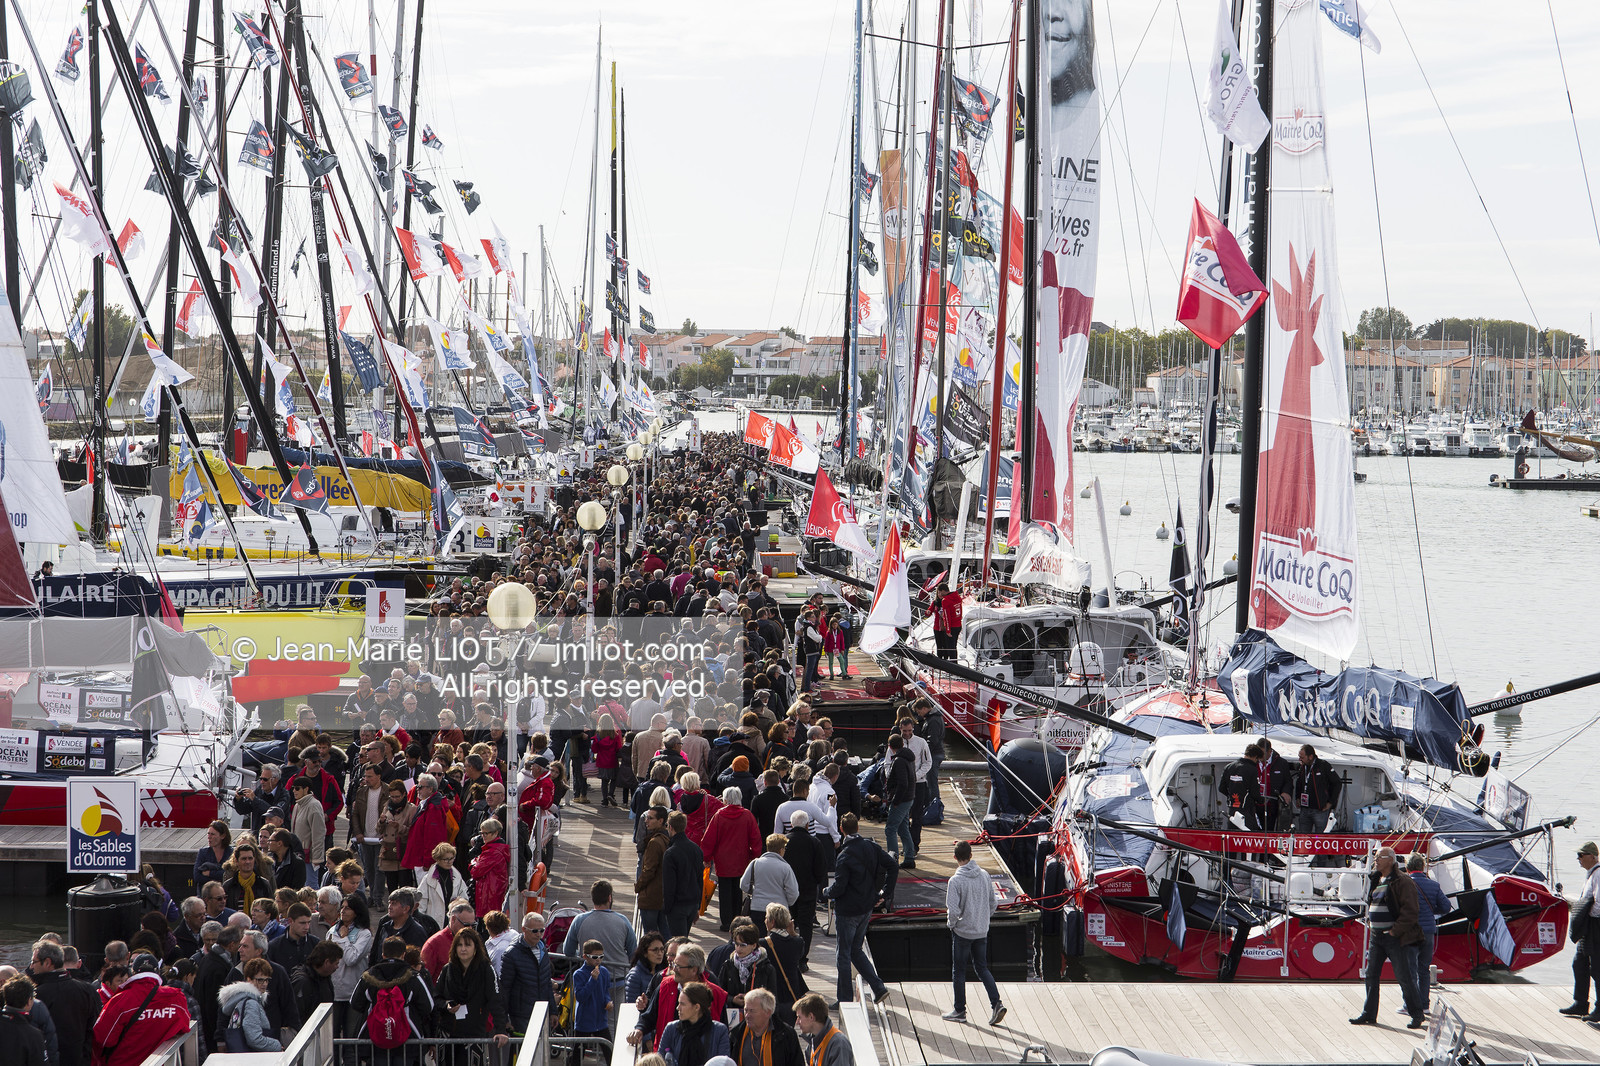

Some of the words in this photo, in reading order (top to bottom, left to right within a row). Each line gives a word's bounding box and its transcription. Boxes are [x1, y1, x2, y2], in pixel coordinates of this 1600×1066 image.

[745, 436, 764, 446] VENDÉE
[770, 453, 791, 466] VENDÉE
[806, 523, 833, 537] VENDÉE
[1257, 546, 1314, 588] Maître
[1317, 561, 1353, 603] CoQ
[263, 585, 291, 608] DU
[296, 582, 325, 605] LIT
[370, 625, 398, 634] VENDÉE
[982, 676, 1054, 706] www.maitrecoq.com
[95, 695, 118, 703] VENDÉE
[1469, 686, 1551, 715] www.maitrecoq.com
[43, 702, 71, 710] OCEAN
[84, 709, 121, 719] Sodebo
[44, 755, 85, 768] Sodebo
[78, 839, 92, 851] les
[93, 839, 132, 853] Sables
[74, 852, 127, 866] d'Olonne
[1521, 892, 1537, 902] LO
[137, 1007, 177, 1020] STAFF
